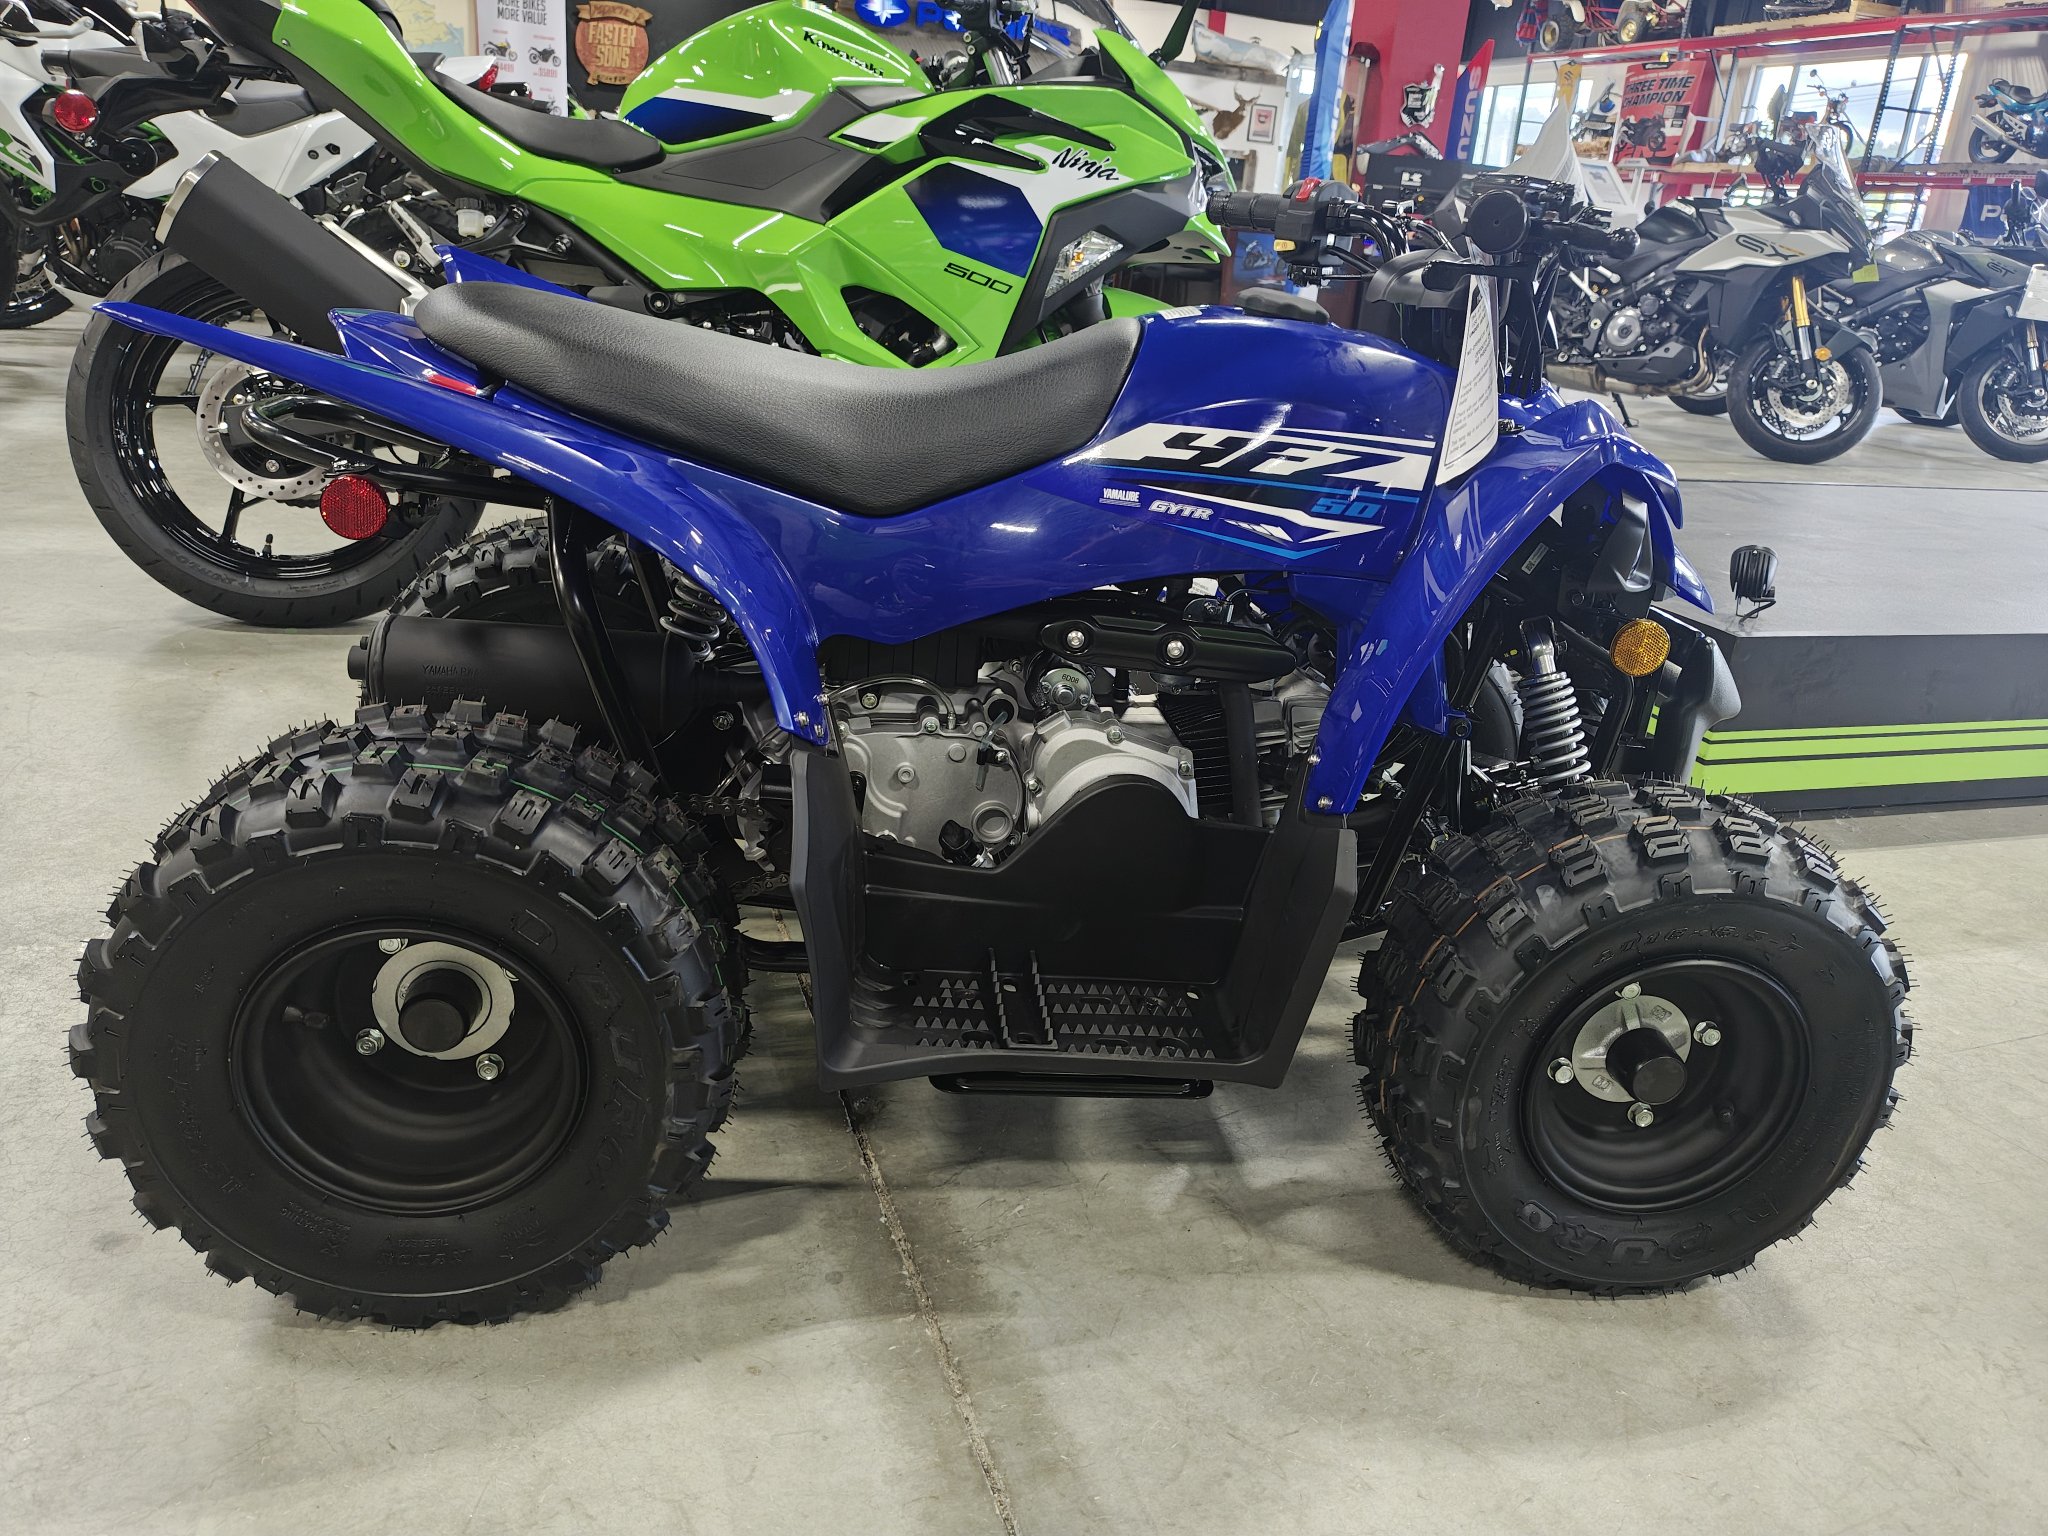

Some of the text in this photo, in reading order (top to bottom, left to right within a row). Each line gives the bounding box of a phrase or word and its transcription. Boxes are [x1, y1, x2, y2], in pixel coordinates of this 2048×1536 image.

[523, 0, 546, 11] BIKES
[497, 9, 547, 25] MORE VALUE
[588, 22, 637, 47] FASTER
[596, 45, 630, 69] SONS
[803, 31, 884, 78] Kawasaki
[1625, 79, 1657, 94] THREE
[1658, 76, 1695, 90] TIME
[1623, 91, 1686, 107] CHAMPION
[1052, 147, 1119, 181] Ninja
[943, 262, 1013, 295] 500
[1150, 431, 1425, 491] YFZ
[1102, 487, 1141, 502] YAMALUBE
[1148, 499, 1215, 521] GYTR
[1311, 496, 1383, 519] 50
[1061, 673, 1080, 685] 6D08
